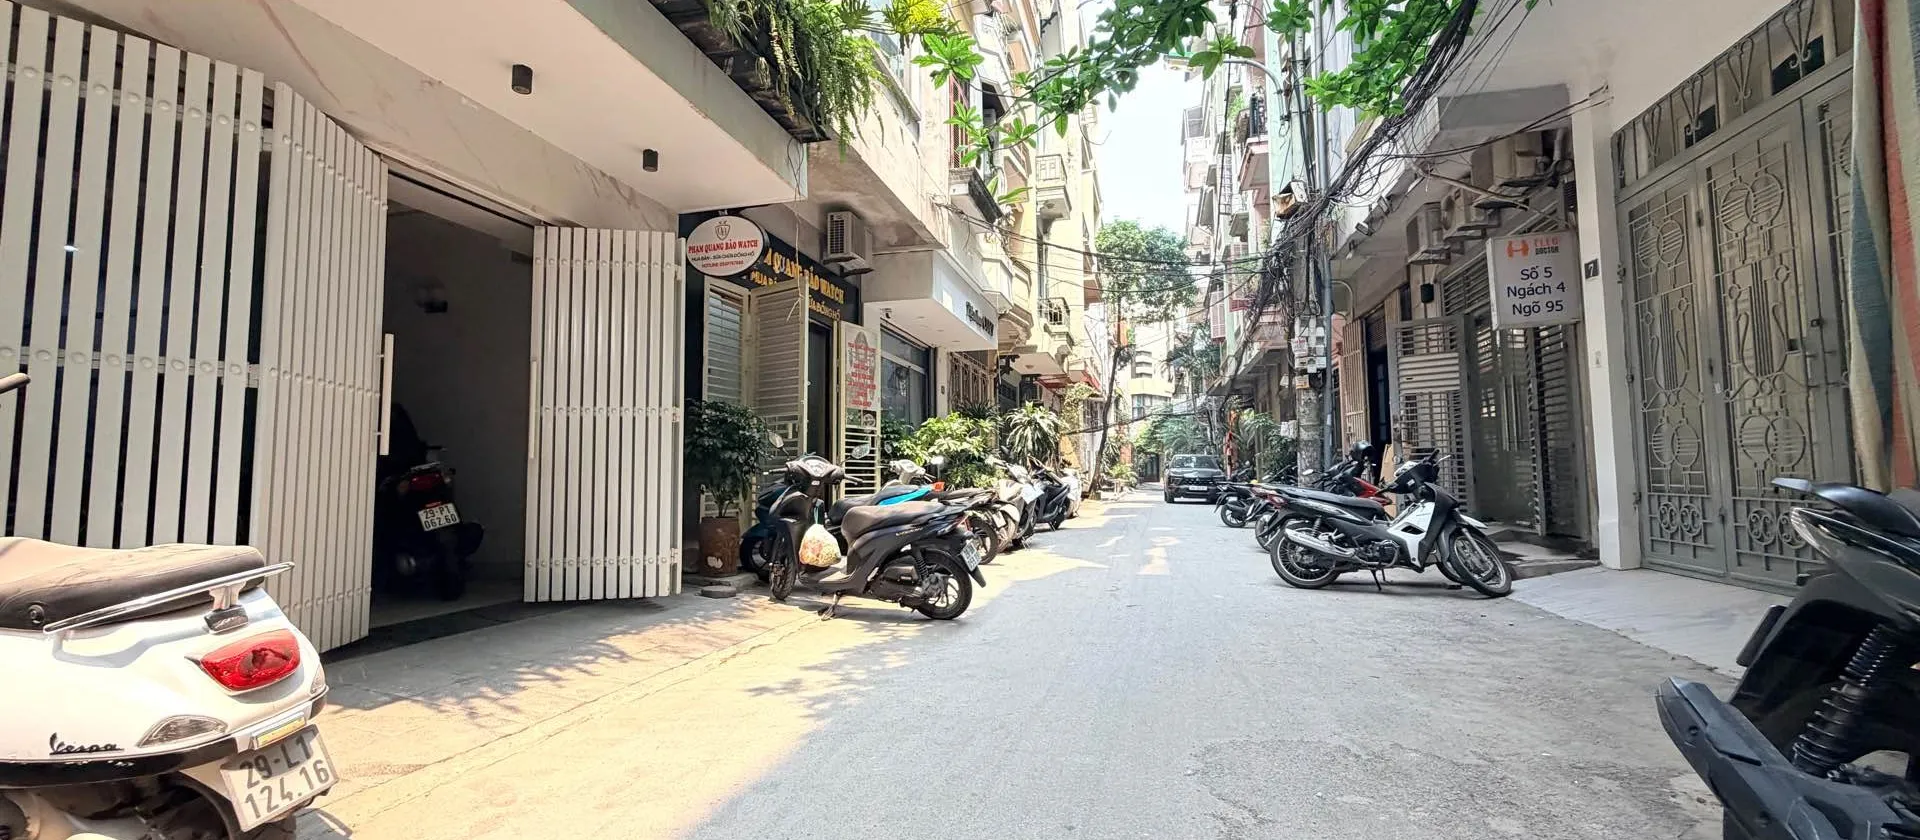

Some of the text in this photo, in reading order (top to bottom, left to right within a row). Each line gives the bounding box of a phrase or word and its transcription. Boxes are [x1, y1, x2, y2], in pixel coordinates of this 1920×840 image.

[704, 242, 724, 253] QUANG
[738, 240, 758, 249] WATCH
[1521, 266, 1553, 281] Số 5
[1588, 264, 1594, 277] 7
[820, 278, 844, 304] WATCH
[1507, 281, 1566, 299] Ngách 4
[1512, 300, 1564, 317] Ngõ 95
[49, 732, 124, 756] Vespa
[240, 735, 312, 788] 29-L1
[245, 760, 330, 819] 124.16
